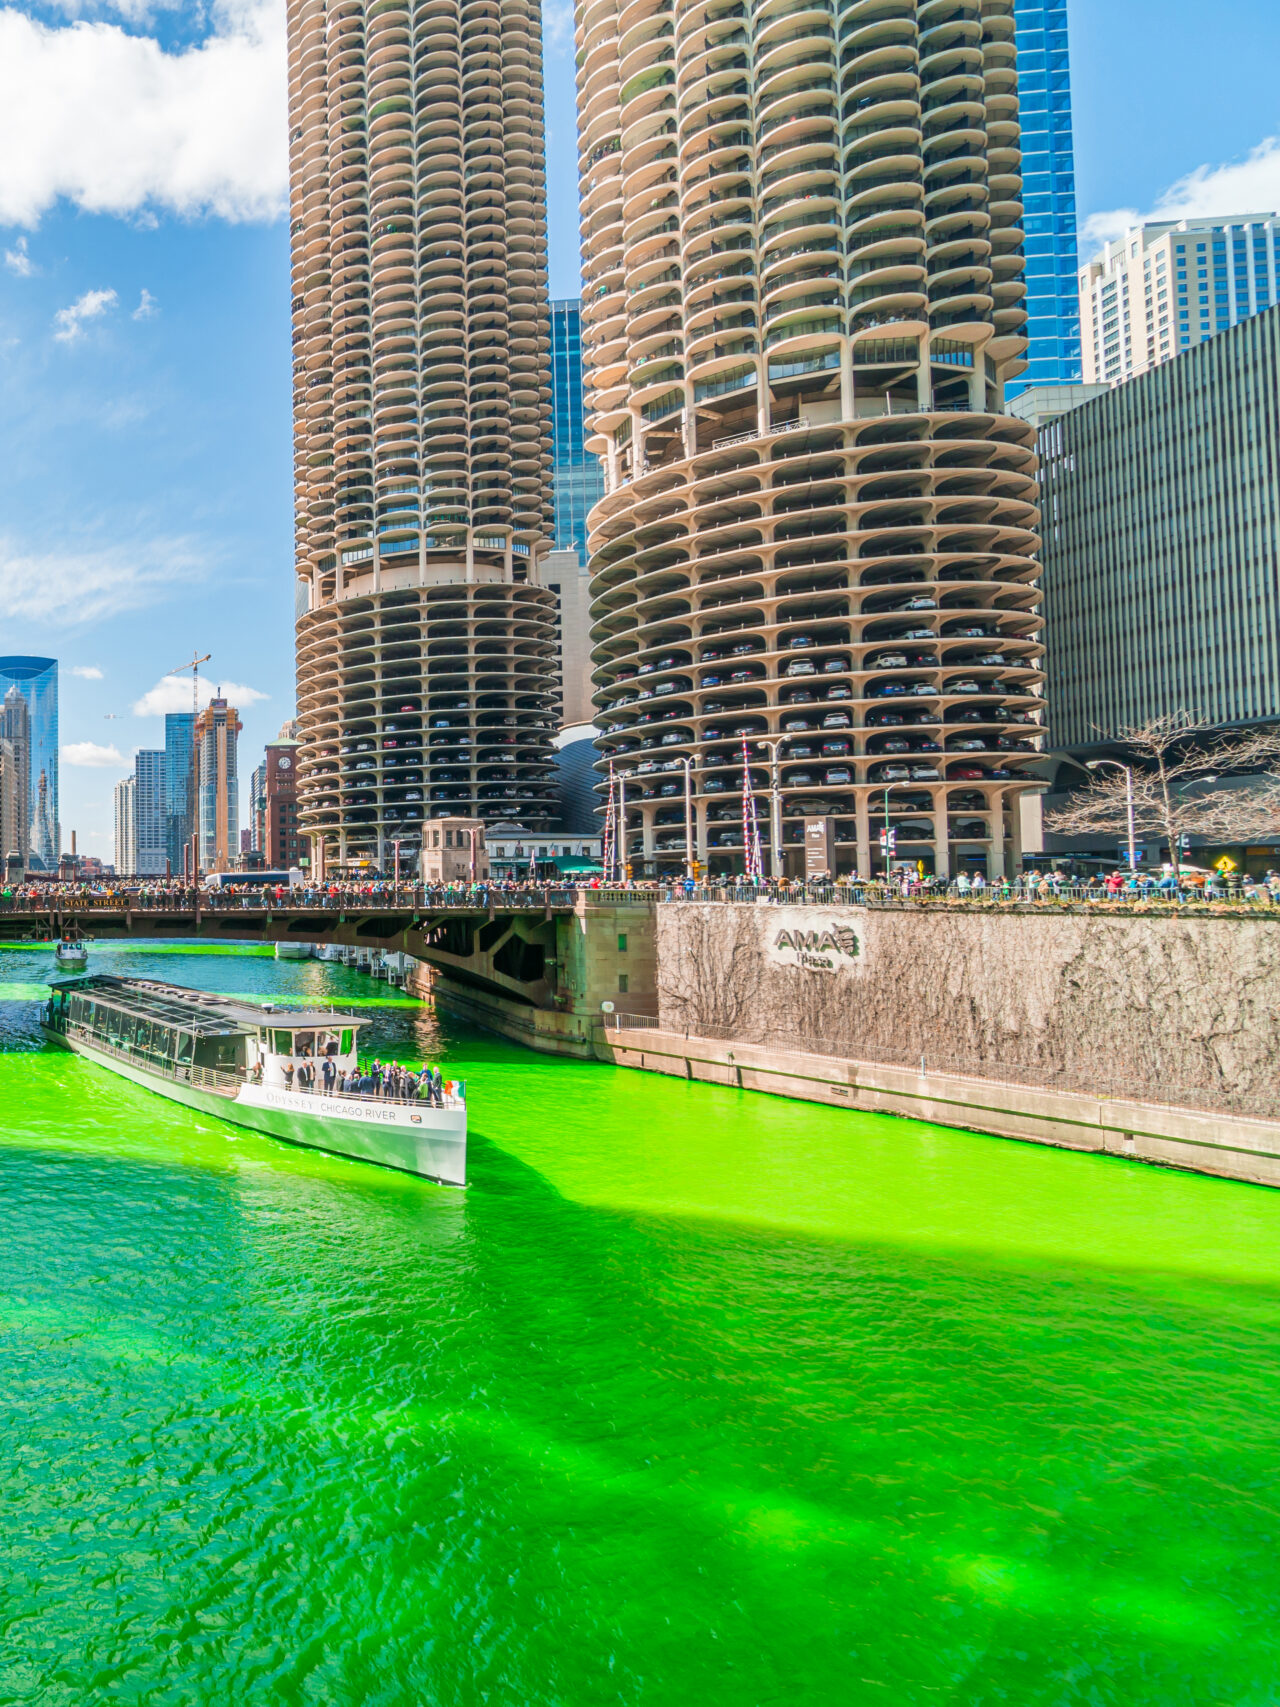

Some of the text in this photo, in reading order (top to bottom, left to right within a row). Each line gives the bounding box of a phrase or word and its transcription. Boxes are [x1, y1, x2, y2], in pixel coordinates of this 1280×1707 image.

[65, 898, 125, 907] STATE STREET
[773, 928, 839, 953] AMA
[320, 1102, 362, 1117] CHICAGO
[365, 1107, 396, 1121] RIVER
